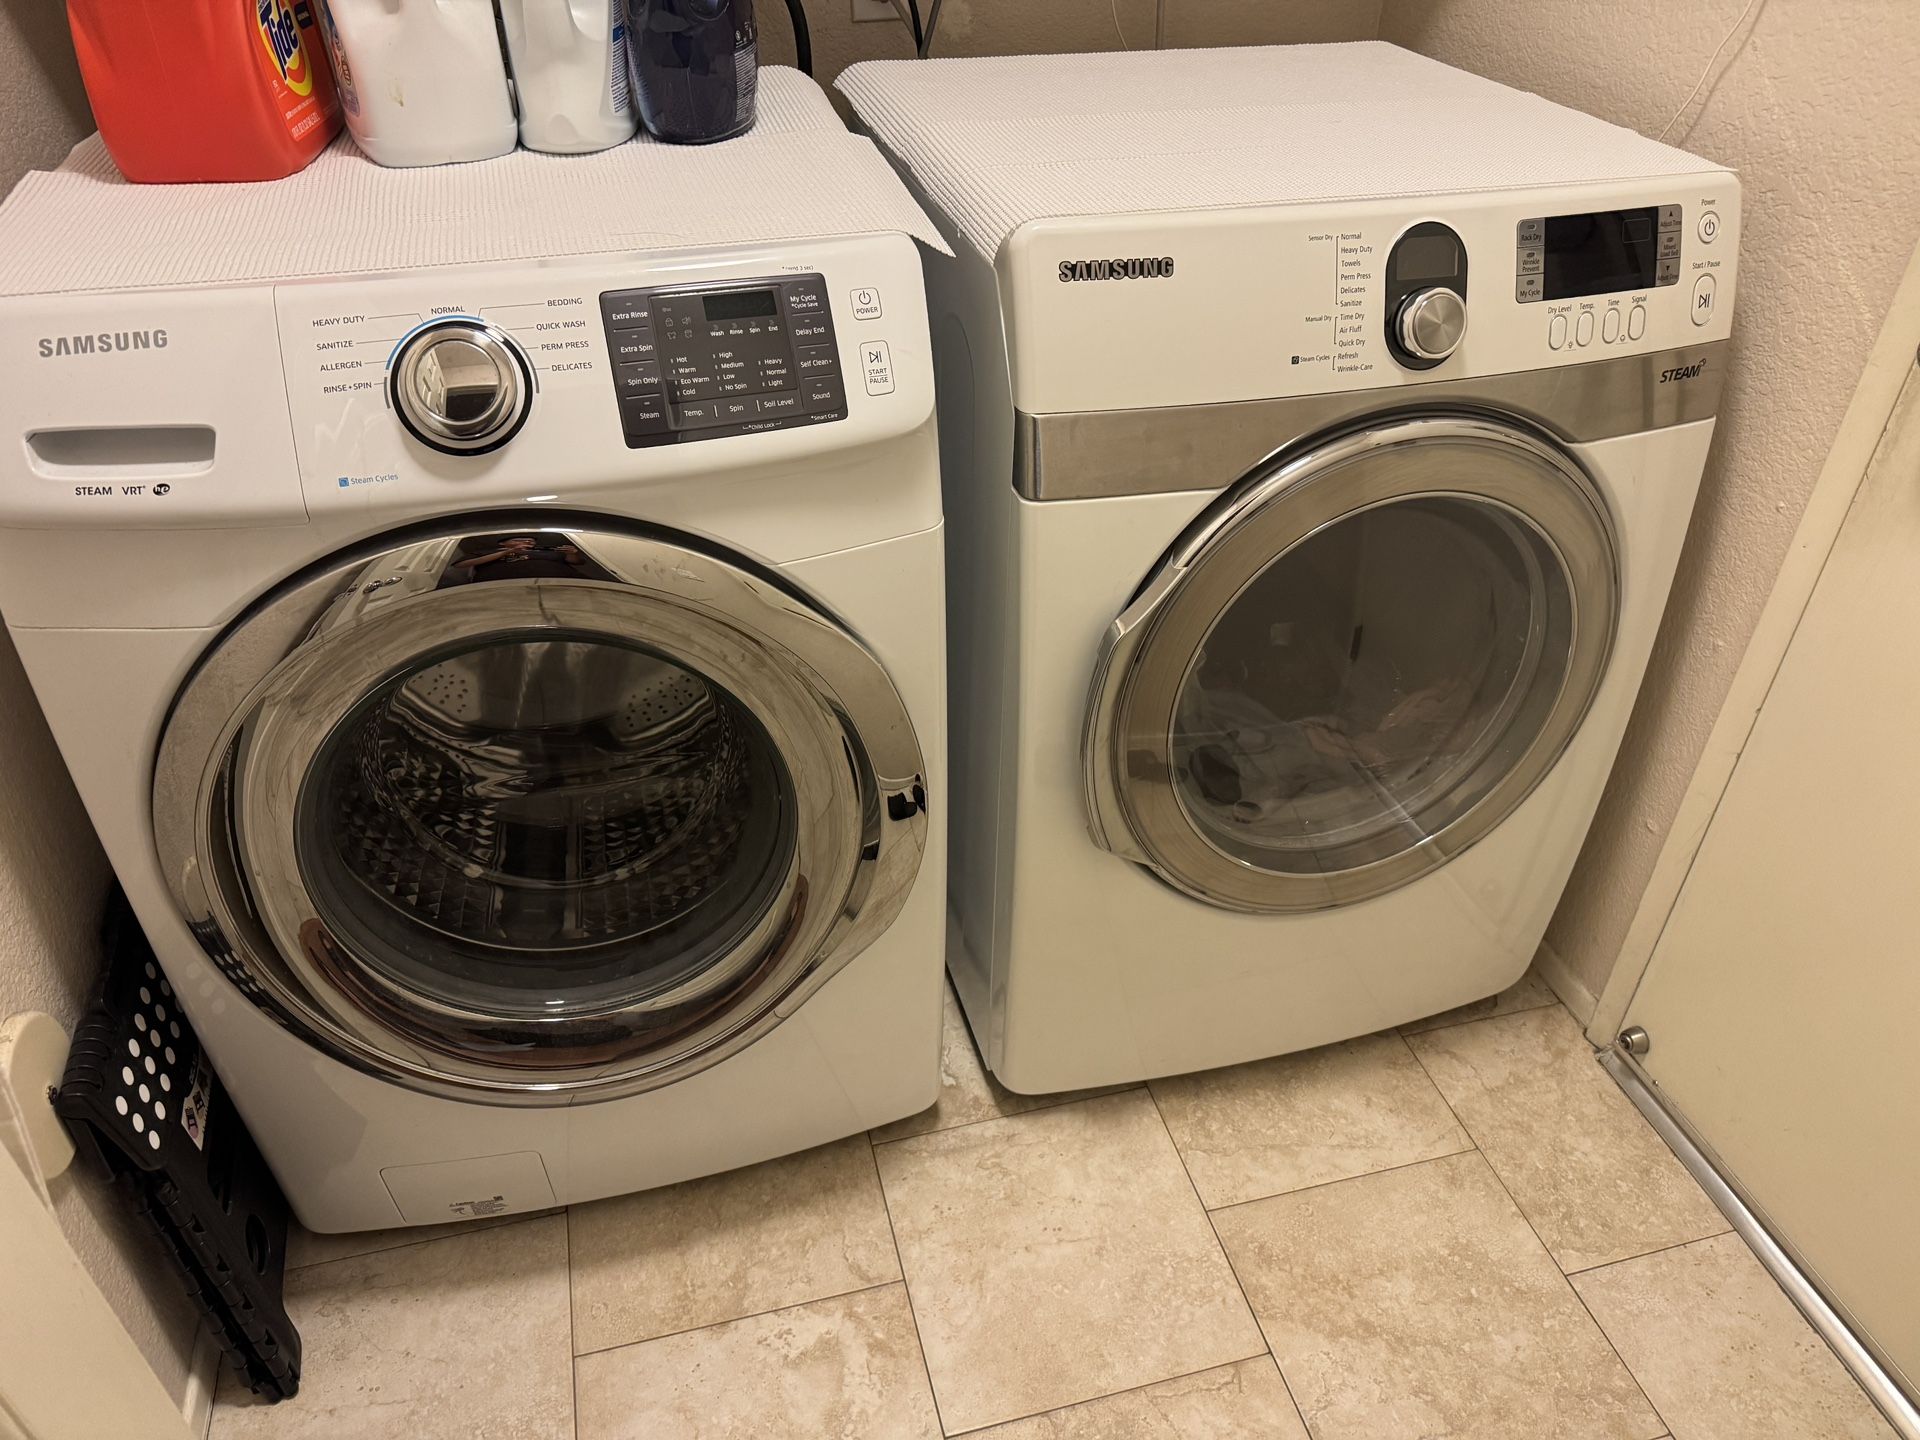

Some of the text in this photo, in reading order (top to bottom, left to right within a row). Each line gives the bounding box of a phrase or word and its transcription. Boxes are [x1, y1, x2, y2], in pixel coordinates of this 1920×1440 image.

[260, 0, 300, 84] Tide
[1701, 198, 1716, 206] Power
[1308, 233, 1334, 242] Sensor Dry
[1340, 232, 1362, 240] Normal
[1533, 233, 1542, 242] Dry
[1340, 245, 1373, 255] Heavy Duty
[1341, 260, 1361, 268] Towels
[1522, 258, 1540, 266] Wrinkle
[1692, 262, 1704, 270] Start
[1707, 260, 1721, 268] Pause
[1058, 256, 1175, 283] SAMSUNG
[1521, 265, 1540, 273] Prevent
[1340, 272, 1372, 282] Perm Press
[1340, 286, 1366, 294] Delicates
[1519, 288, 1541, 298] My Cycle
[547, 297, 583, 307] BEDDING
[800, 293, 817, 302] Cycle
[1631, 294, 1648, 305] Signal
[1340, 300, 1363, 308] Sanitize
[1579, 302, 1595, 311] Temp.
[1607, 299, 1620, 307] Time
[430, 305, 466, 315] NORMAL
[856, 306, 879, 315] POWER
[1547, 304, 1573, 315] Dry Level
[612, 310, 649, 321] Extra Rinse
[1305, 314, 1333, 323] Manual Dry
[1339, 312, 1365, 322] Time Dry
[312, 315, 366, 328] HEAVY DUTY
[536, 320, 586, 331] QUICK WASH
[795, 326, 826, 337] Delay End
[1339, 324, 1362, 335] Air Fluff
[38, 328, 169, 359] SAMSUNG
[316, 339, 354, 351] SANITIZE
[541, 340, 590, 352] PERM PRESS
[1338, 338, 1366, 348] Quick Dry
[620, 343, 654, 354] Extra Spin
[676, 356, 688, 364] Hot
[718, 351, 734, 360] High
[1300, 354, 1331, 364] Steam Cycles
[1337, 352, 1359, 360] Refresh
[319, 360, 363, 372] ALLERGEN
[551, 361, 593, 372] DELICATES
[720, 361, 745, 370] Medium
[764, 358, 783, 367] Heavy
[800, 360, 812, 368] Self
[1337, 362, 1374, 373] Wrinkle-Care
[678, 367, 697, 375] Warm
[766, 367, 787, 376] Normal
[868, 368, 888, 377] START
[1659, 364, 1702, 384] STEAM
[627, 376, 659, 387] Spin Only
[691, 376, 710, 384] Warm
[722, 373, 736, 381] Low
[869, 376, 889, 385] PAUSE
[734, 382, 748, 392] Spin
[768, 378, 784, 388] Light
[682, 388, 696, 396] Cold
[812, 391, 831, 401] Sound
[684, 397, 794, 419] Temp. Spin Soil Level
[639, 411, 660, 420] Steam
[764, 421, 776, 429] Lock
[350, 474, 399, 485] Steam Cycles
[75, 485, 113, 496] STEAM
